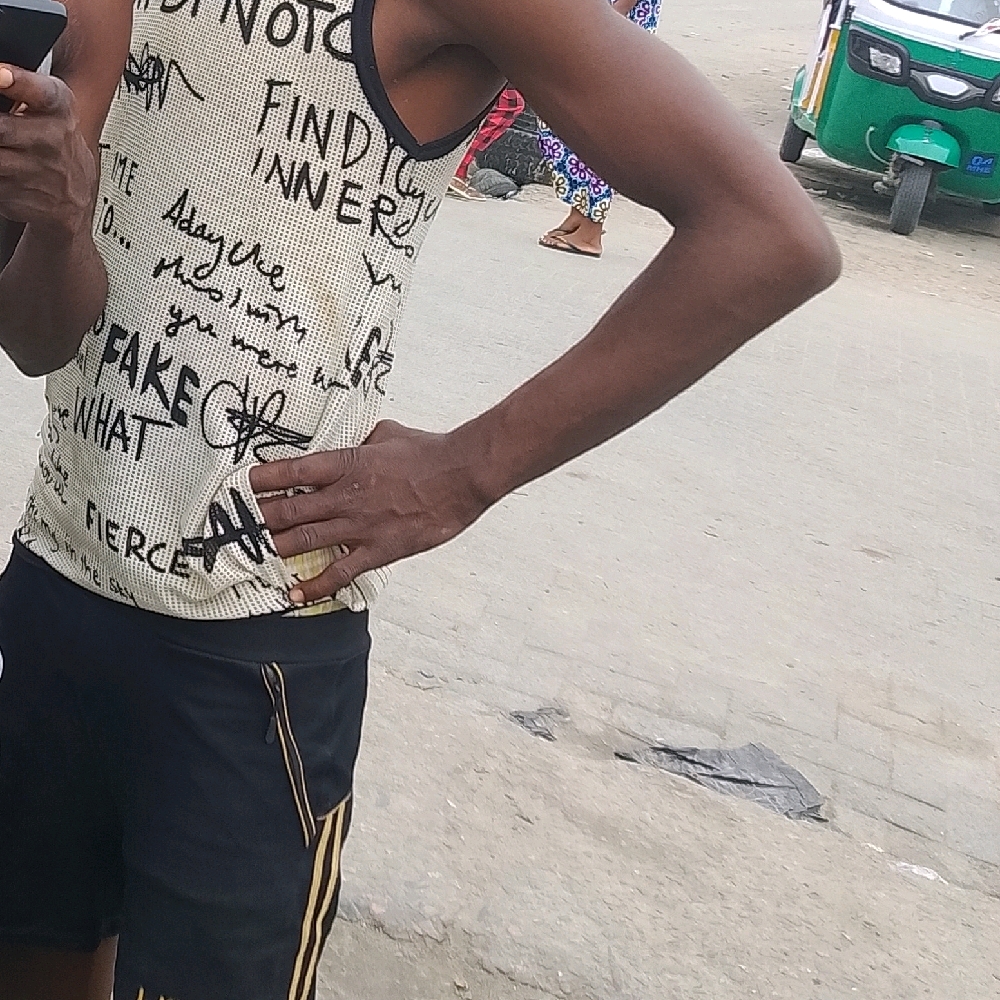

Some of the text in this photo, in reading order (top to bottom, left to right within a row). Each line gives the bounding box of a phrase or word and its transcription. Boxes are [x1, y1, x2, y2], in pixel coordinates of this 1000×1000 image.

[256, 79, 372, 170] FIND
[252, 147, 406, 246] INNER
[96, 323, 201, 428] FAKE
[74, 386, 174, 462] WHAT
[87, 500, 192, 580] FIERCE
